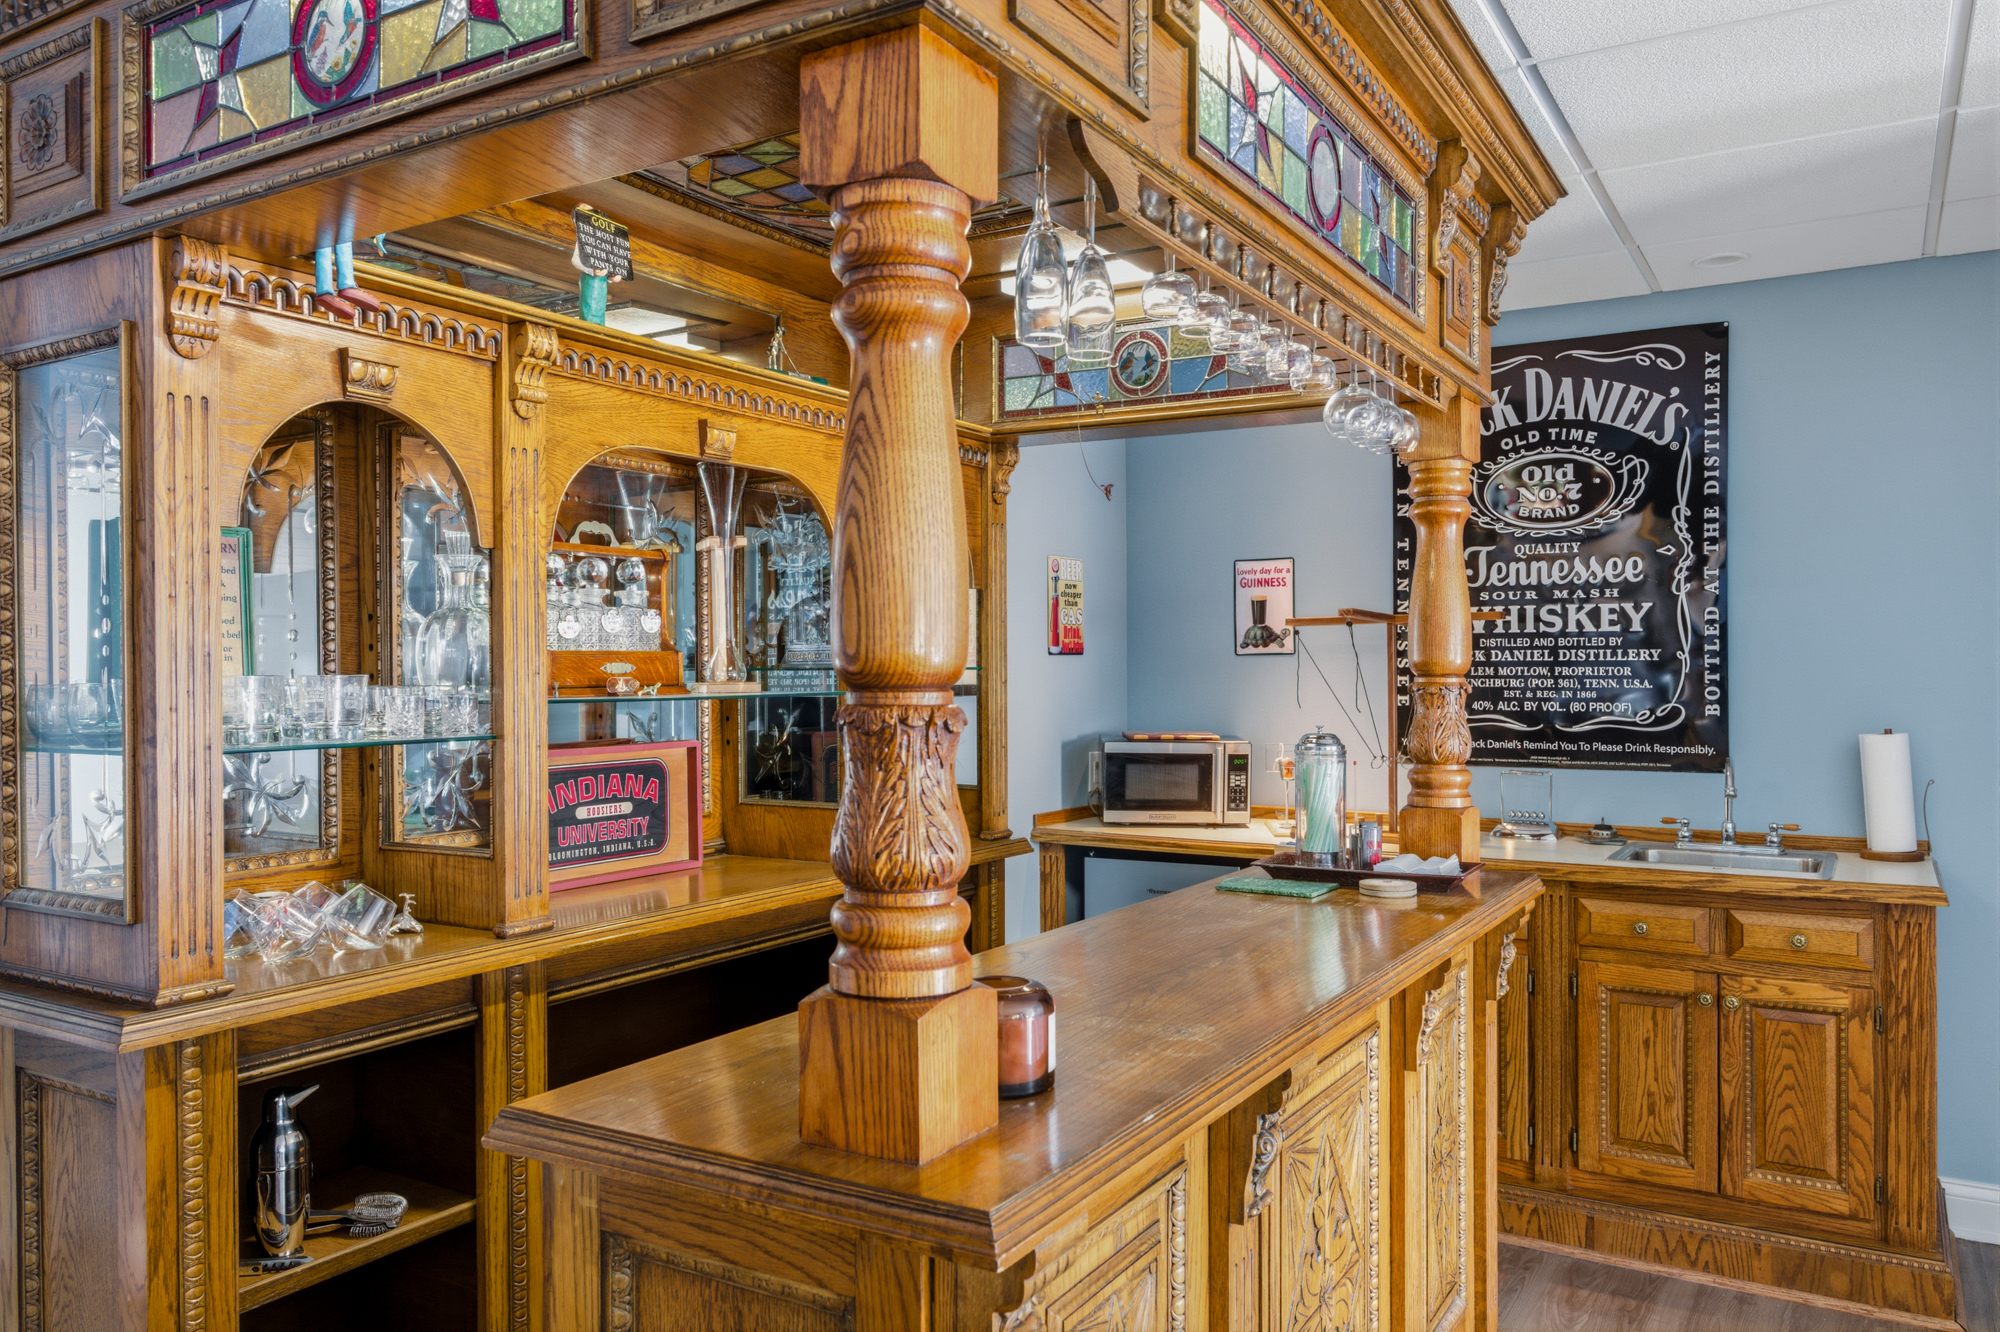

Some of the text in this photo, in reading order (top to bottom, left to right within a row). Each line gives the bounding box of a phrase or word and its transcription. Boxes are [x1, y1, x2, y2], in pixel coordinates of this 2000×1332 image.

[592, 217, 616, 233] GOLF
[579, 223, 630, 248] THE MOST FUN
[580, 233, 631, 259] YOU CAN HAVE
[584, 245, 629, 268] WITH YOUR
[590, 257, 627, 277] PANTS ON
[1480, 368, 1689, 446] CK DANIEL'S
[1501, 428, 1598, 450] OLD TIME
[1522, 464, 1575, 483] Old
[1398, 488, 1409, 517] IN
[1519, 504, 1580, 519] BRAND
[1703, 351, 1720, 716] BOTTLED AT THE DISTILLERY
[1514, 542, 1580, 557] QUALITY
[1060, 558, 1082, 582] BEER
[1236, 567, 1257, 576] Lovely
[1259, 567, 1272, 576] day
[1274, 566, 1284, 574] for
[1464, 545, 1644, 588] Tennessee
[1239, 576, 1287, 589] GUINNESS
[1061, 590, 1082, 601] cheaper
[1480, 588, 1620, 600] SOUR MASH
[1064, 599, 1078, 607] than
[1060, 608, 1083, 625] GAS
[227, 630, 240, 638] bed
[1480, 637, 1623, 647] DISTILLED AND BOTTLED BY
[1490, 649, 1553, 661] DANIEL
[1558, 649, 1661, 661] DISTILLERY
[1471, 666, 1632, 677] LEM MOTLOW, PROPRIETOR
[1528, 678, 1555, 689] (POP.
[1558, 678, 1580, 689] 361),
[1584, 679, 1619, 688] TENN.
[1624, 679, 1653, 689] U.S.A.
[1504, 690, 1597, 698] EST. & REG. IN 1866
[1472, 701, 1632, 714] 40% ALC. BY VOL. (80 PROOF)
[1471, 739, 1716, 756] ack Daniel's Remind You To Please Drink Responsibly.
[548, 773, 659, 815] INDIANA
[558, 816, 649, 847] UNIVERSITY
[603, 841, 634, 854] INDIANA,
